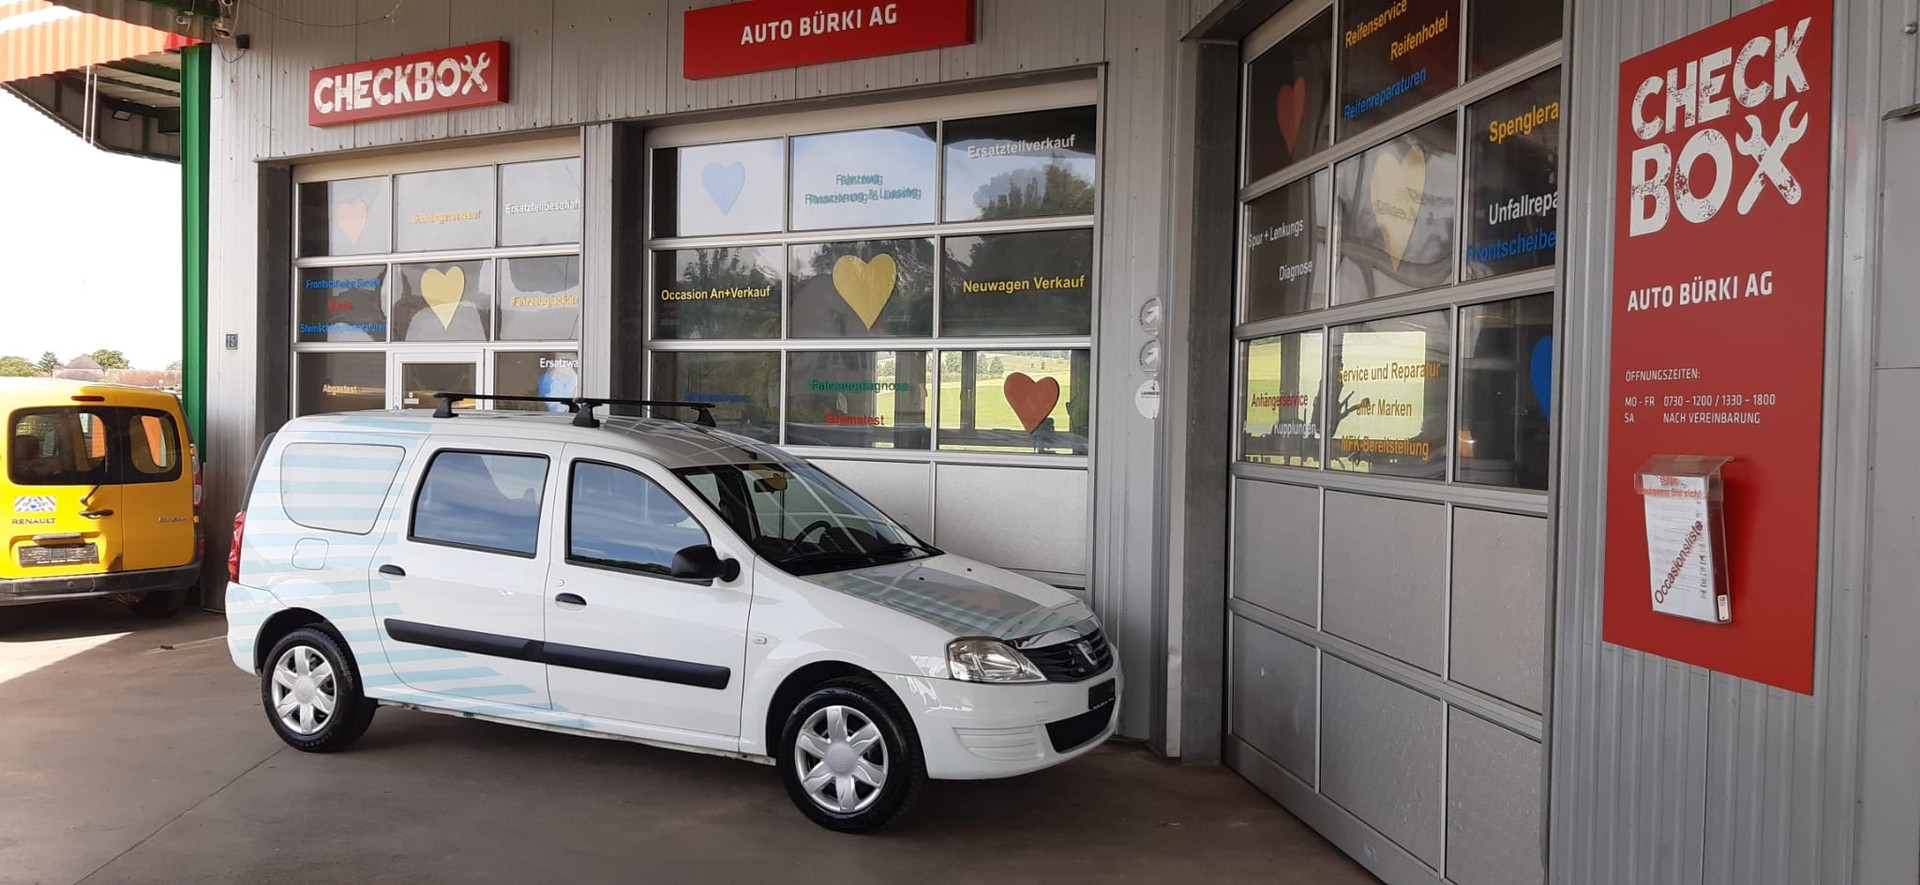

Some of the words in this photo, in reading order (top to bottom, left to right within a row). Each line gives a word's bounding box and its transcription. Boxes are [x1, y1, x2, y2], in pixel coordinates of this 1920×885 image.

[740, 19, 792, 46] AUTO
[799, 8, 862, 37] BÜRKI
[868, 3, 897, 28] AG
[1345, 0, 1408, 49] Reifenservice
[1390, 9, 1448, 61] Reifenhotel
[313, 51, 490, 115] CHECKBOX
[1630, 16, 1812, 141] CHECK
[1343, 67, 1427, 120] Reifenreparaturen
[1489, 101, 1559, 145] Spenglera
[967, 134, 1076, 159] Ersatzteilverkauf
[1629, 100, 1809, 238] BOX
[1269, 219, 1304, 242] Lenkungs
[1279, 260, 1312, 282] Diagnose
[661, 288, 708, 300] Occasion
[710, 285, 771, 300] An+Verkauf
[963, 278, 1030, 294] Neuwagen
[1033, 274, 1086, 290] Verkauf
[1627, 285, 1674, 312] AUTO
[1680, 275, 1738, 306] BÜRKI
[1744, 270, 1773, 298] AG
[540, 357, 578, 369] Ersatzwa
[1337, 365, 1369, 384] Service
[1371, 363, 1389, 381] und
[1391, 361, 1441, 383] Reparatur
[1625, 367, 1701, 382] ÖFFNUNGSZEITEN:
[1251, 391, 1309, 411] Anhängerservice
[1377, 398, 1413, 417] Marken
[1624, 395, 1638, 407] MO
[1644, 395, 1656, 407] FR
[1663, 395, 1684, 407] 0730
[1692, 394, 1713, 407] 1200
[1714, 394, 1719, 408] /
[1722, 394, 1742, 406] 1330
[1753, 393, 1776, 406] 1800
[1624, 412, 1635, 424] SA
[1663, 412, 1686, 424] NACH
[1688, 412, 1761, 424] VEREINBARUNG
[1341, 436, 1429, 460] MFK-Bereitstellung
[1654, 519, 1704, 605] Occasionsliste
